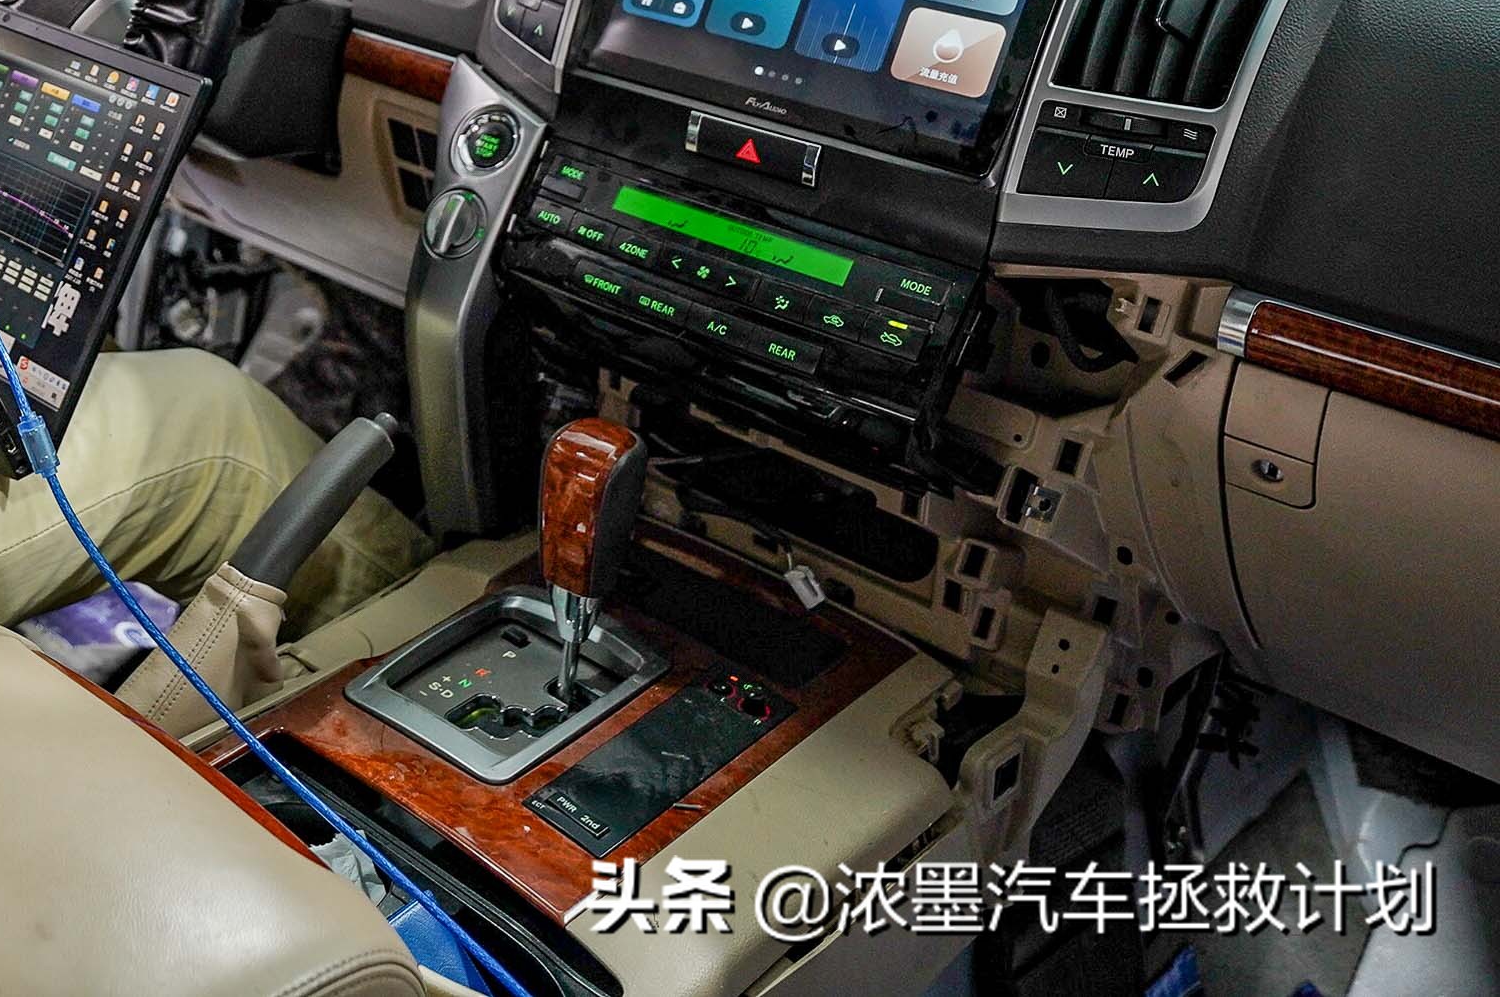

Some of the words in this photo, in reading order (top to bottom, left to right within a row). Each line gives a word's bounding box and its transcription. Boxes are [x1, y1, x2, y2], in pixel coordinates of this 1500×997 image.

[919, 65, 959, 85] 流量充值
[1100, 144, 1135, 159] TEMP
[561, 164, 585, 182] MODE
[537, 209, 561, 225] AUTO
[586, 227, 605, 243] OFF
[618, 241, 649, 260] 4ZONE
[592, 276, 622, 296] FRONT
[900, 278, 933, 297] MODE
[650, 299, 676, 317] REAR
[706, 321, 728, 337] A/C
[768, 342, 797, 361] REAR
[502, 650, 516, 661] P
[458, 676, 473, 689] N
[555, 794, 578, 814] PWR
[579, 814, 602, 831] 2nd
